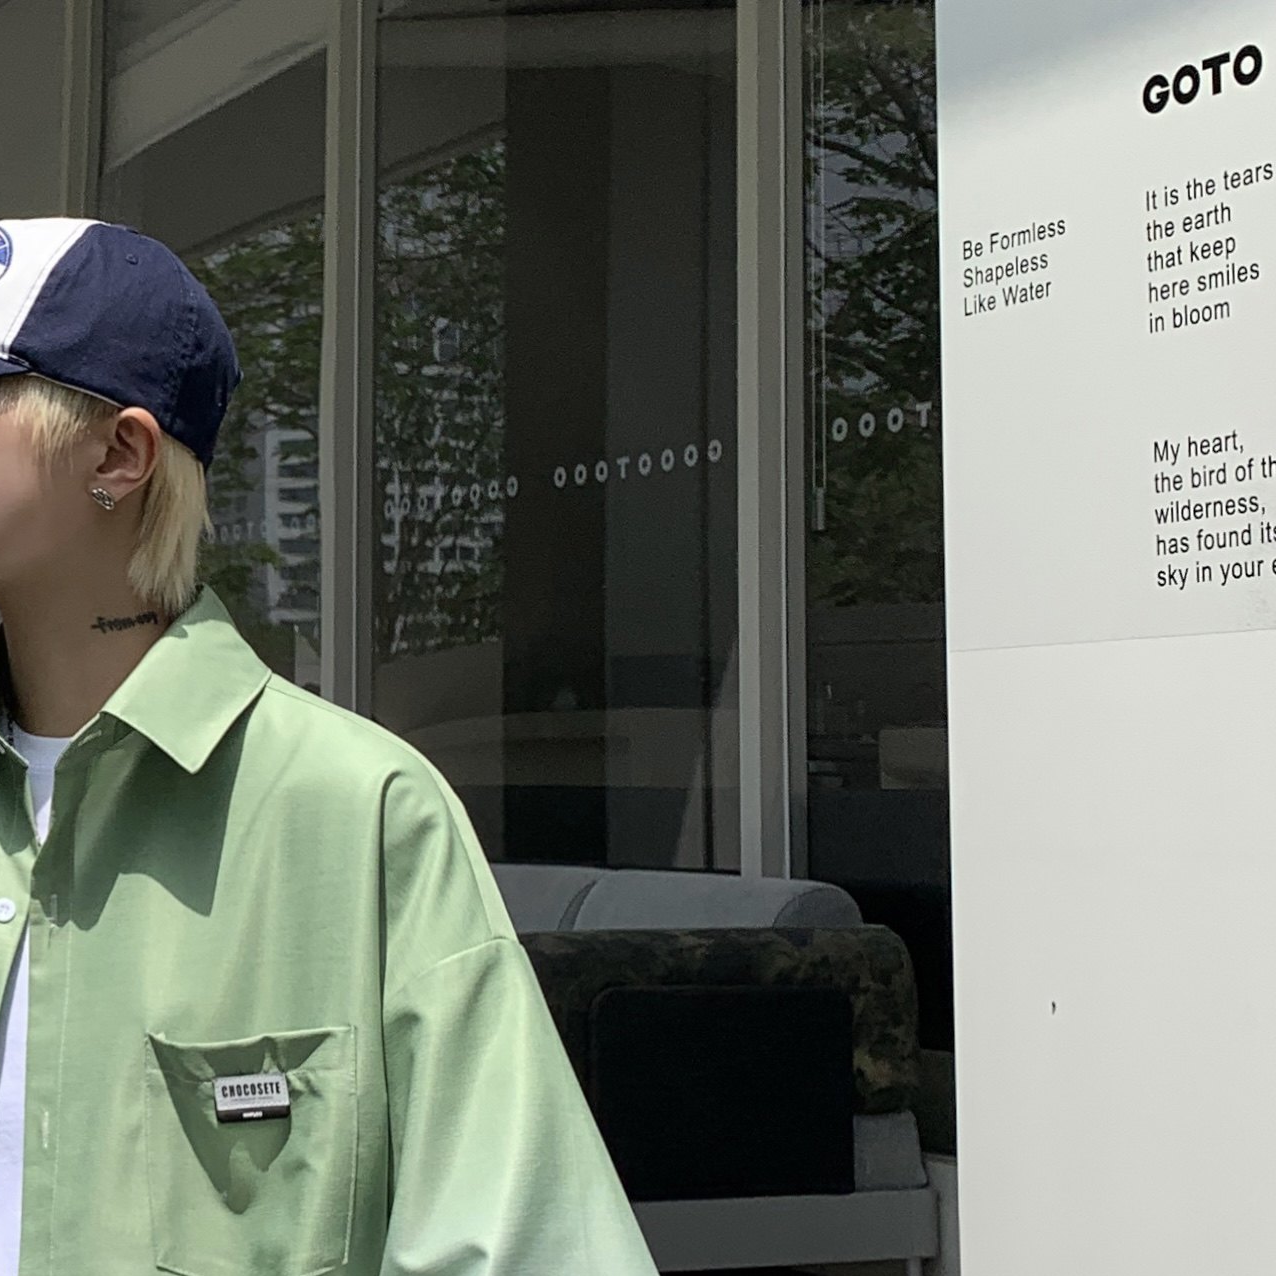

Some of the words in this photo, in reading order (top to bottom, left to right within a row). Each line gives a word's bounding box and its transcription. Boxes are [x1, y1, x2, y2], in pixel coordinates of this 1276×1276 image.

[1142, 44, 1263, 114] GOTO
[1145, 190, 1158, 212] It
[1164, 186, 1180, 207] is
[1186, 177, 1217, 201] the
[1223, 162, 1274, 191] tears
[962, 240, 984, 260] Be
[989, 219, 1066, 253] Formless
[1146, 219, 1175, 242] the
[1182, 203, 1231, 232] earth
[963, 253, 1049, 288] Shapeless
[1147, 248, 1183, 273] that
[1189, 236, 1236, 263] keep
[964, 295, 997, 317] Like
[1002, 280, 1052, 308] Water
[1148, 279, 1190, 303] here
[1197, 262, 1260, 291] smiles
[1149, 311, 1165, 334] in
[1173, 300, 1231, 329] bloom
[1153, 440, 1181, 466] My
[1187, 429, 1244, 458] heart,
[1154, 471, 1183, 493] the
[1191, 463, 1227, 488] bird
[1235, 458, 1254, 482] of
[1155, 495, 1266, 524] wilderness,
[1156, 534, 1189, 556] has
[1197, 523, 1252, 551] found
[1157, 564, 1189, 591] sky
[1196, 561, 1212, 583] in
[1220, 559, 1264, 586] your
